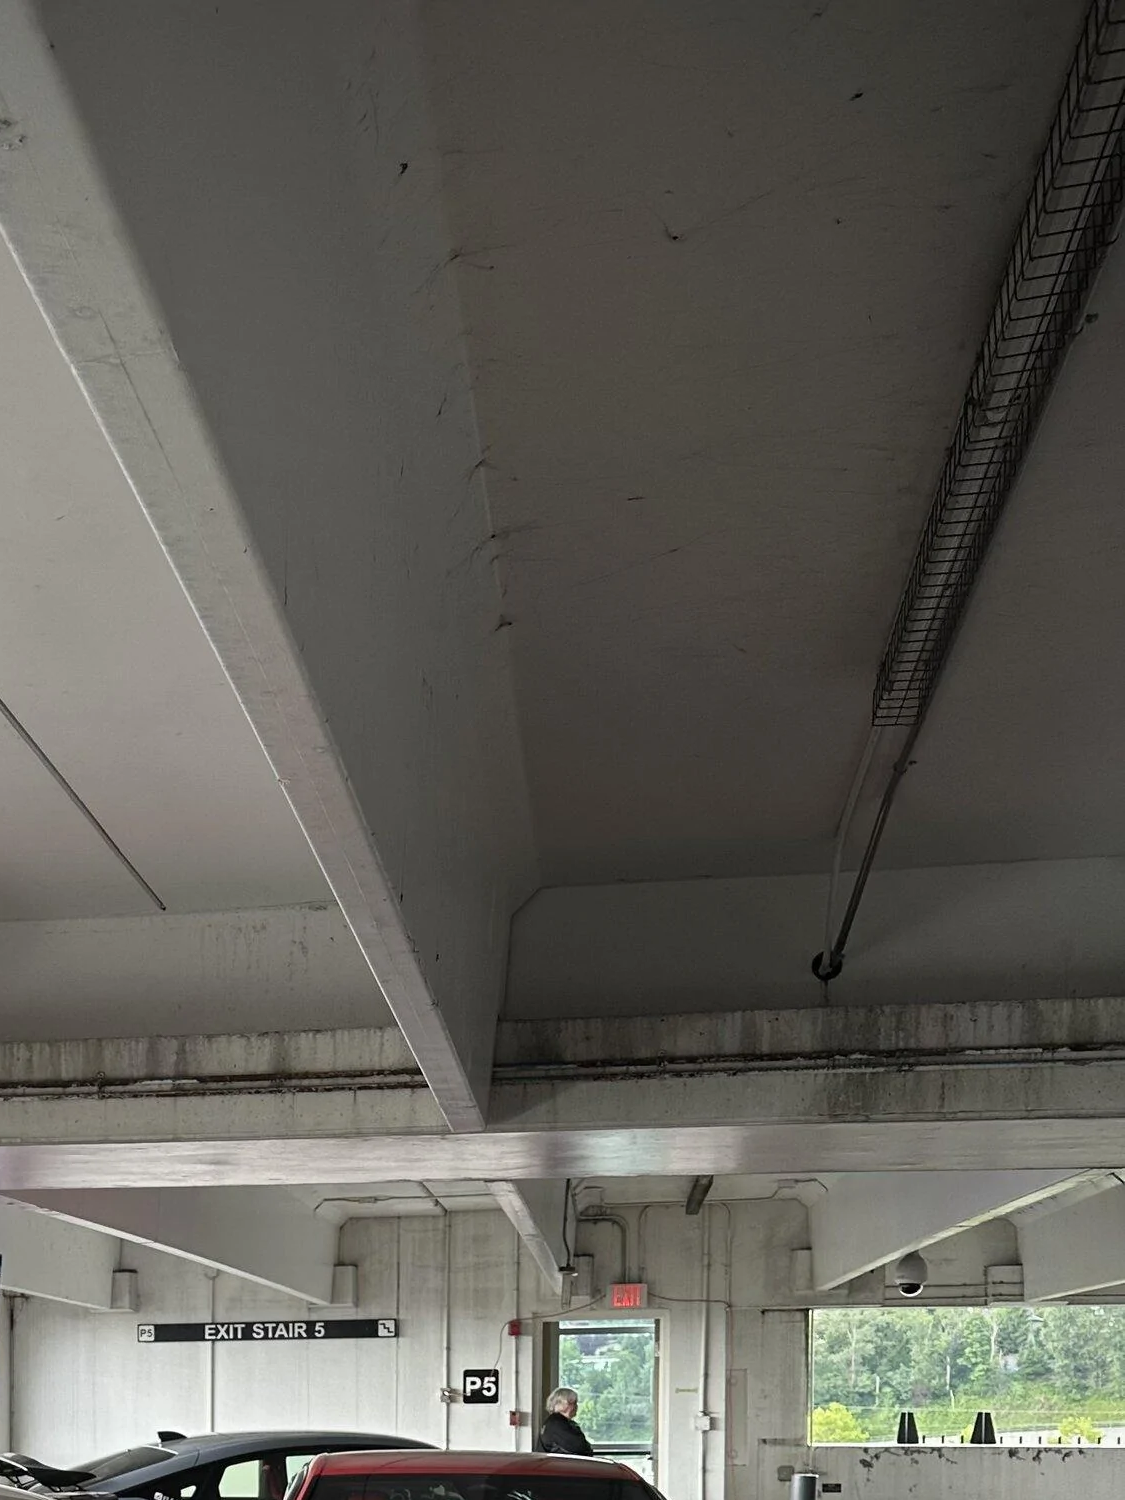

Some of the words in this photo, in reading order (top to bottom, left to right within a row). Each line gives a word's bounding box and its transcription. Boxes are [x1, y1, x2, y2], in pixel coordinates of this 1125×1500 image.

[140, 1328, 153, 1338] P5
[204, 1323, 245, 1340] EXIT
[252, 1322, 308, 1340] STAIR
[314, 1321, 325, 1338] 5
[465, 1375, 497, 1399] P5
